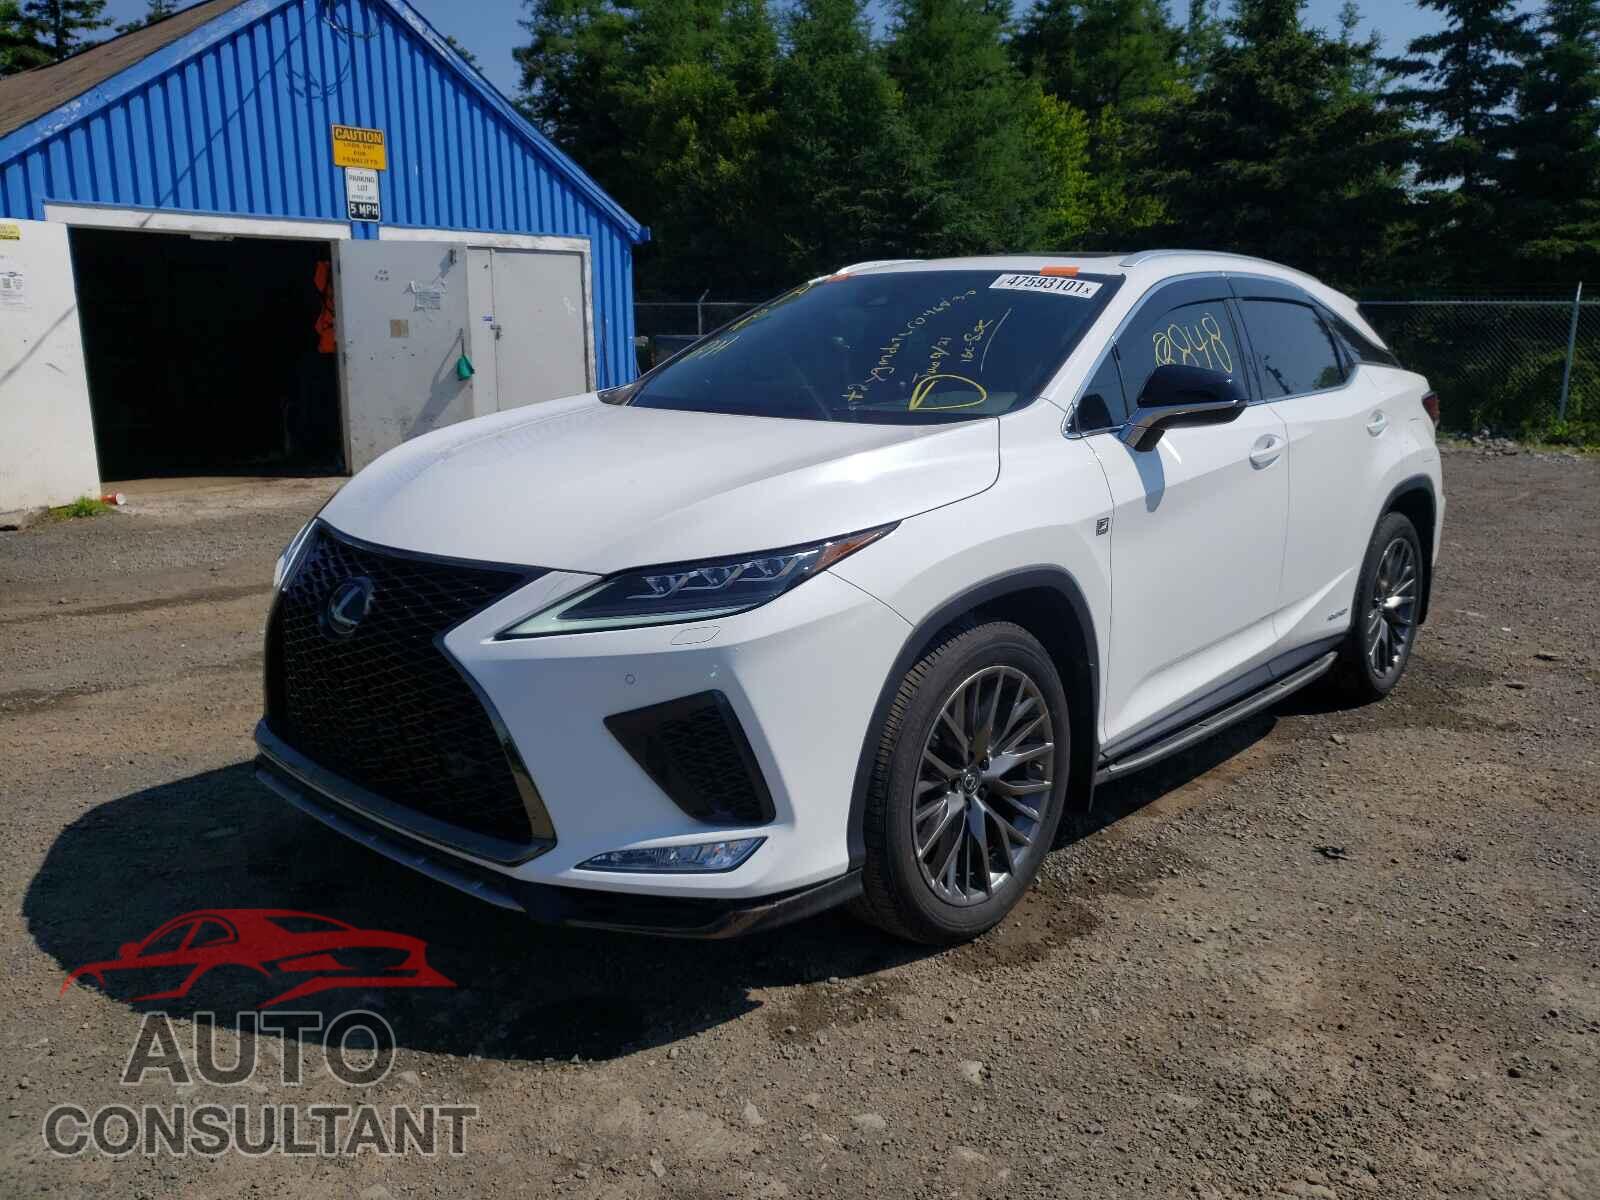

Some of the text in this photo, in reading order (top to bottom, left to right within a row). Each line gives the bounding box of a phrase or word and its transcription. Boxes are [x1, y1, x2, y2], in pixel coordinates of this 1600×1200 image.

[335, 127, 383, 144] CAUTION
[356, 184, 368, 192] LOT
[351, 203, 378, 215] 5 MPH
